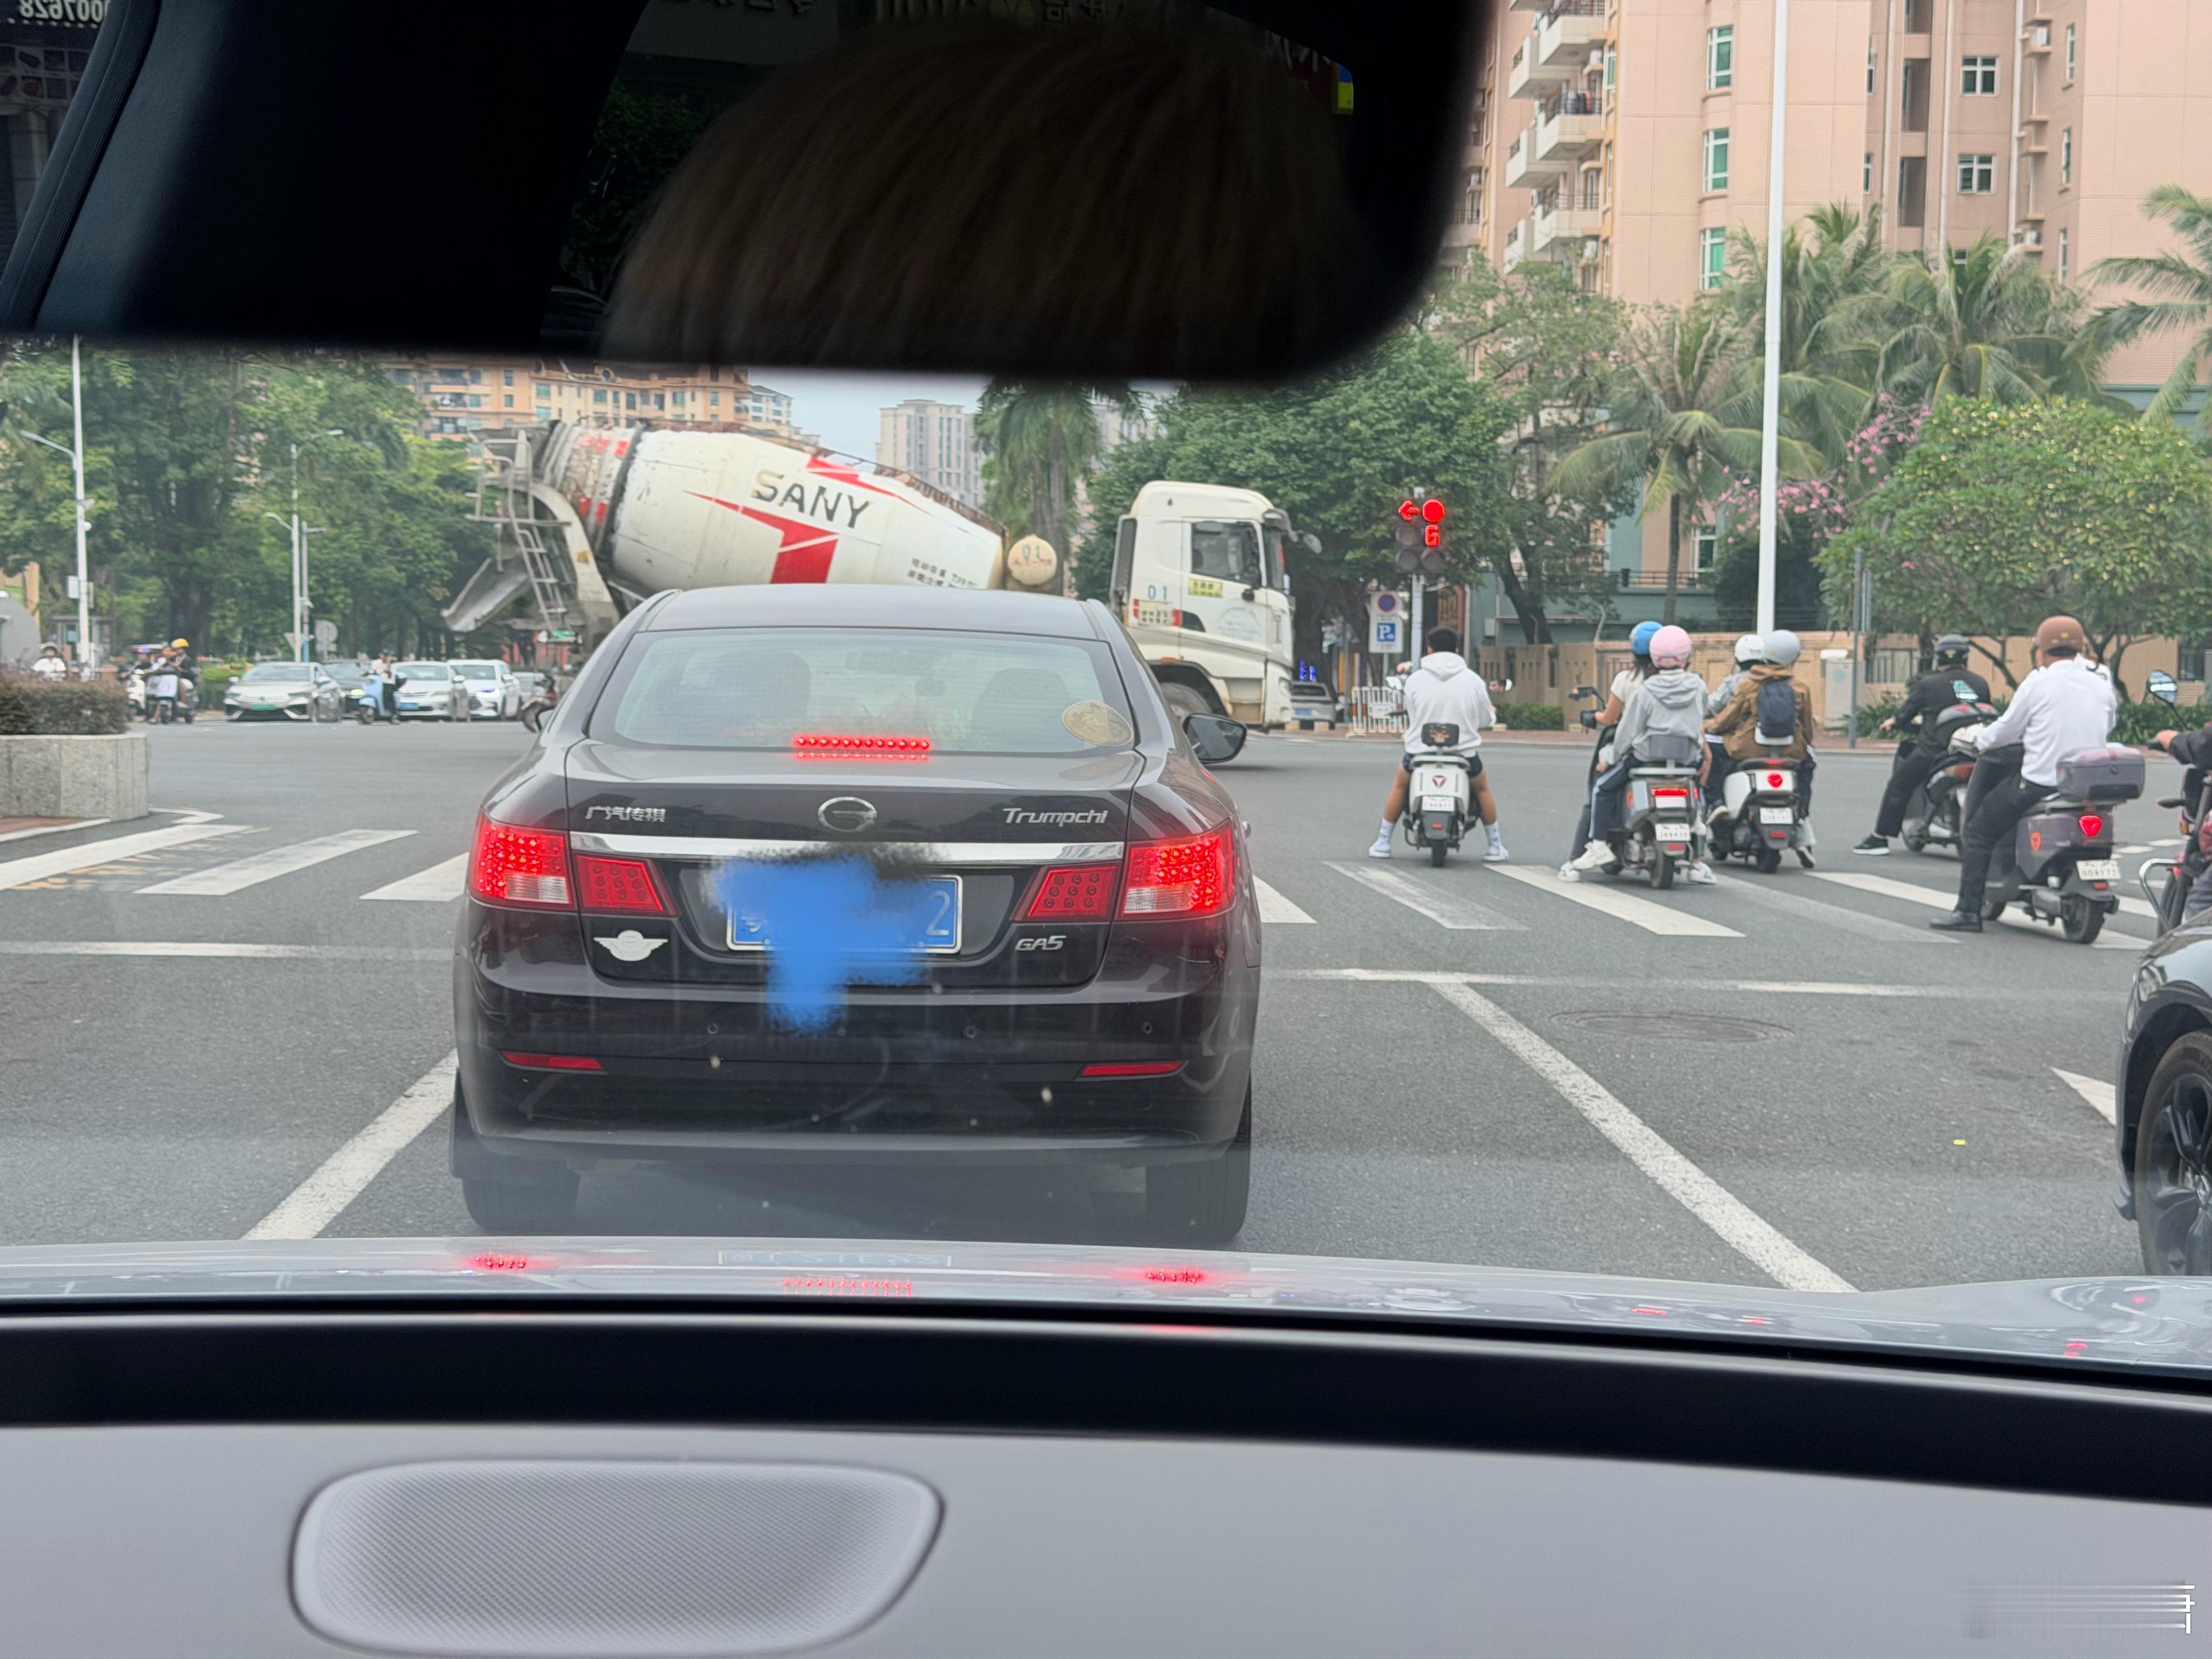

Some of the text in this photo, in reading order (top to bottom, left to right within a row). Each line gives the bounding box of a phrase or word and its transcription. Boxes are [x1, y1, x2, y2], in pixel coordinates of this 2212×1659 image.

[751, 468, 870, 529] SANY
[1424, 524, 1441, 548] 6
[1379, 624, 1391, 640] P
[585, 806, 667, 823] 广汽传祺
[1003, 808, 1109, 827] Trumpchi
[1015, 935, 1067, 951] GA5
